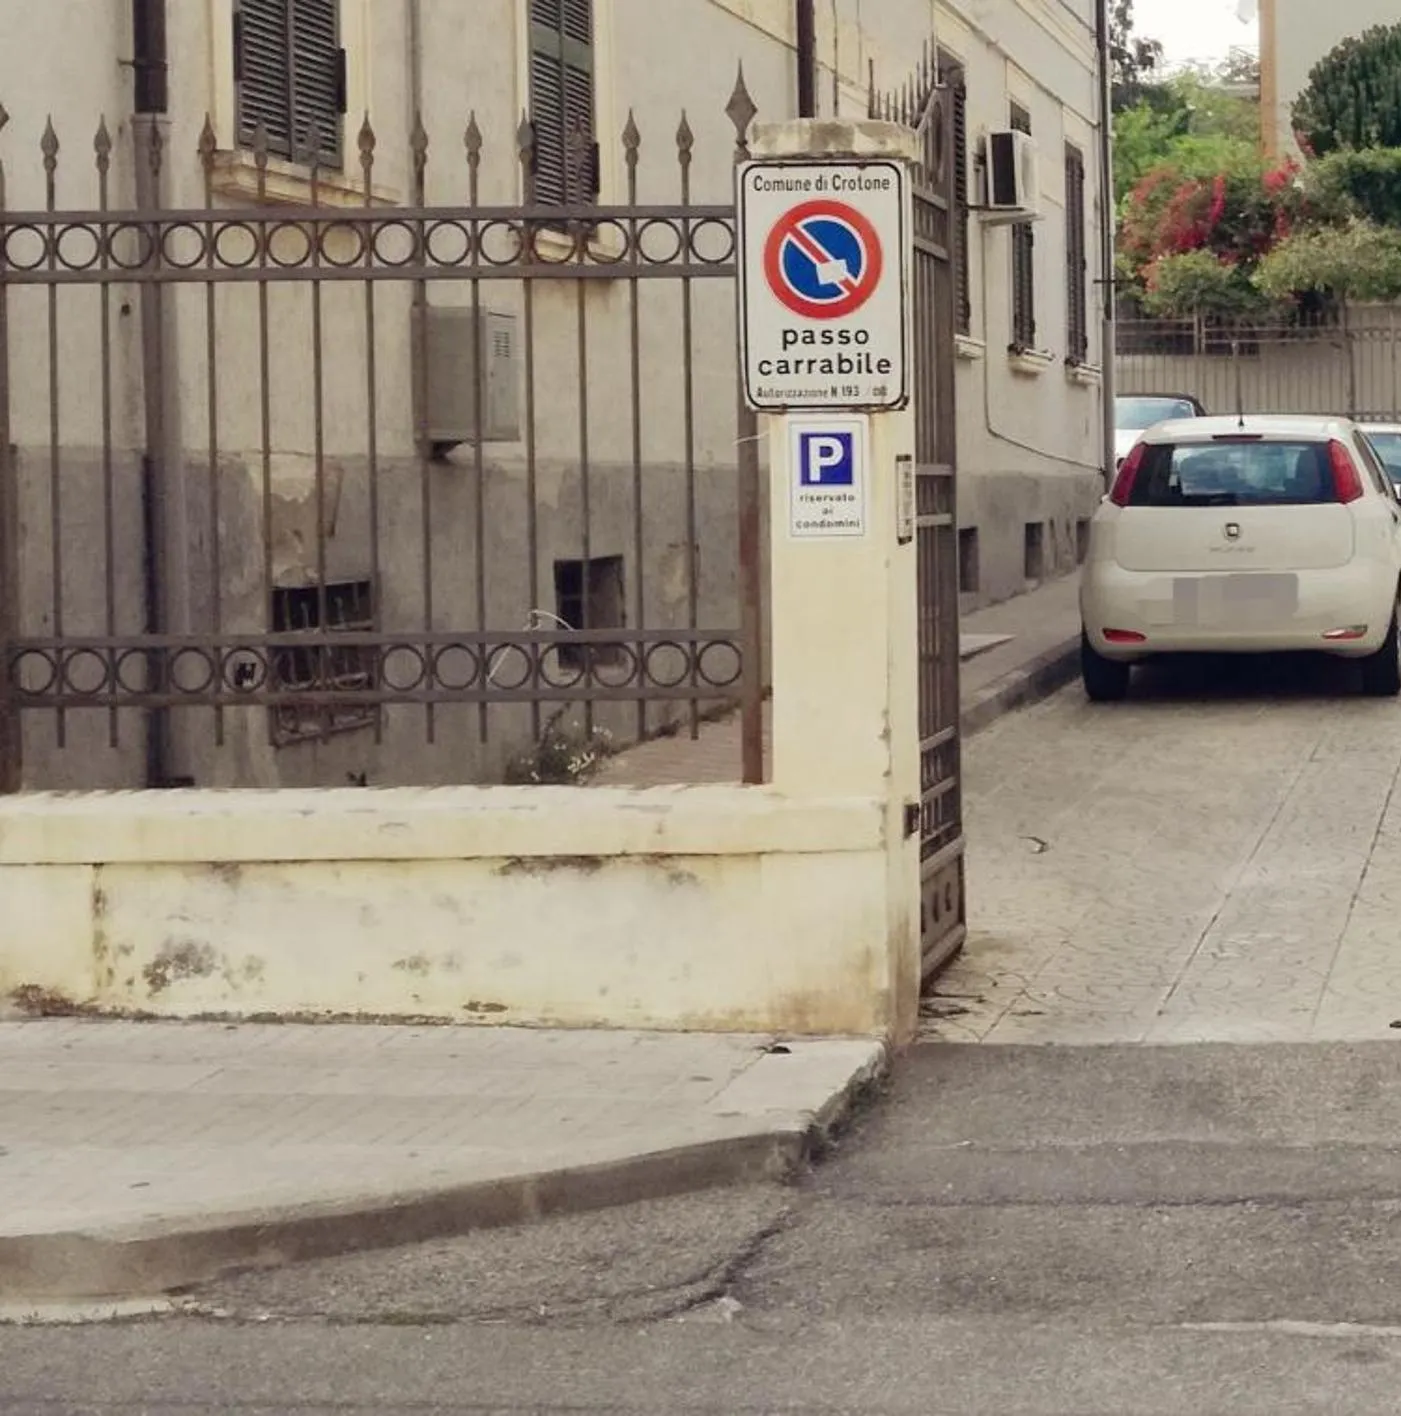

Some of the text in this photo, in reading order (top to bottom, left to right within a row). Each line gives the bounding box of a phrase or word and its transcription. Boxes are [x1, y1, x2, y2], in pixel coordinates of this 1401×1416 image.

[753, 174, 891, 191] Comune di Crotone
[782, 329, 870, 351] passo
[758, 352, 892, 376] carrabile
[808, 436, 844, 482] P
[799, 492, 855, 502] riservato
[795, 516, 860, 529] condomini
